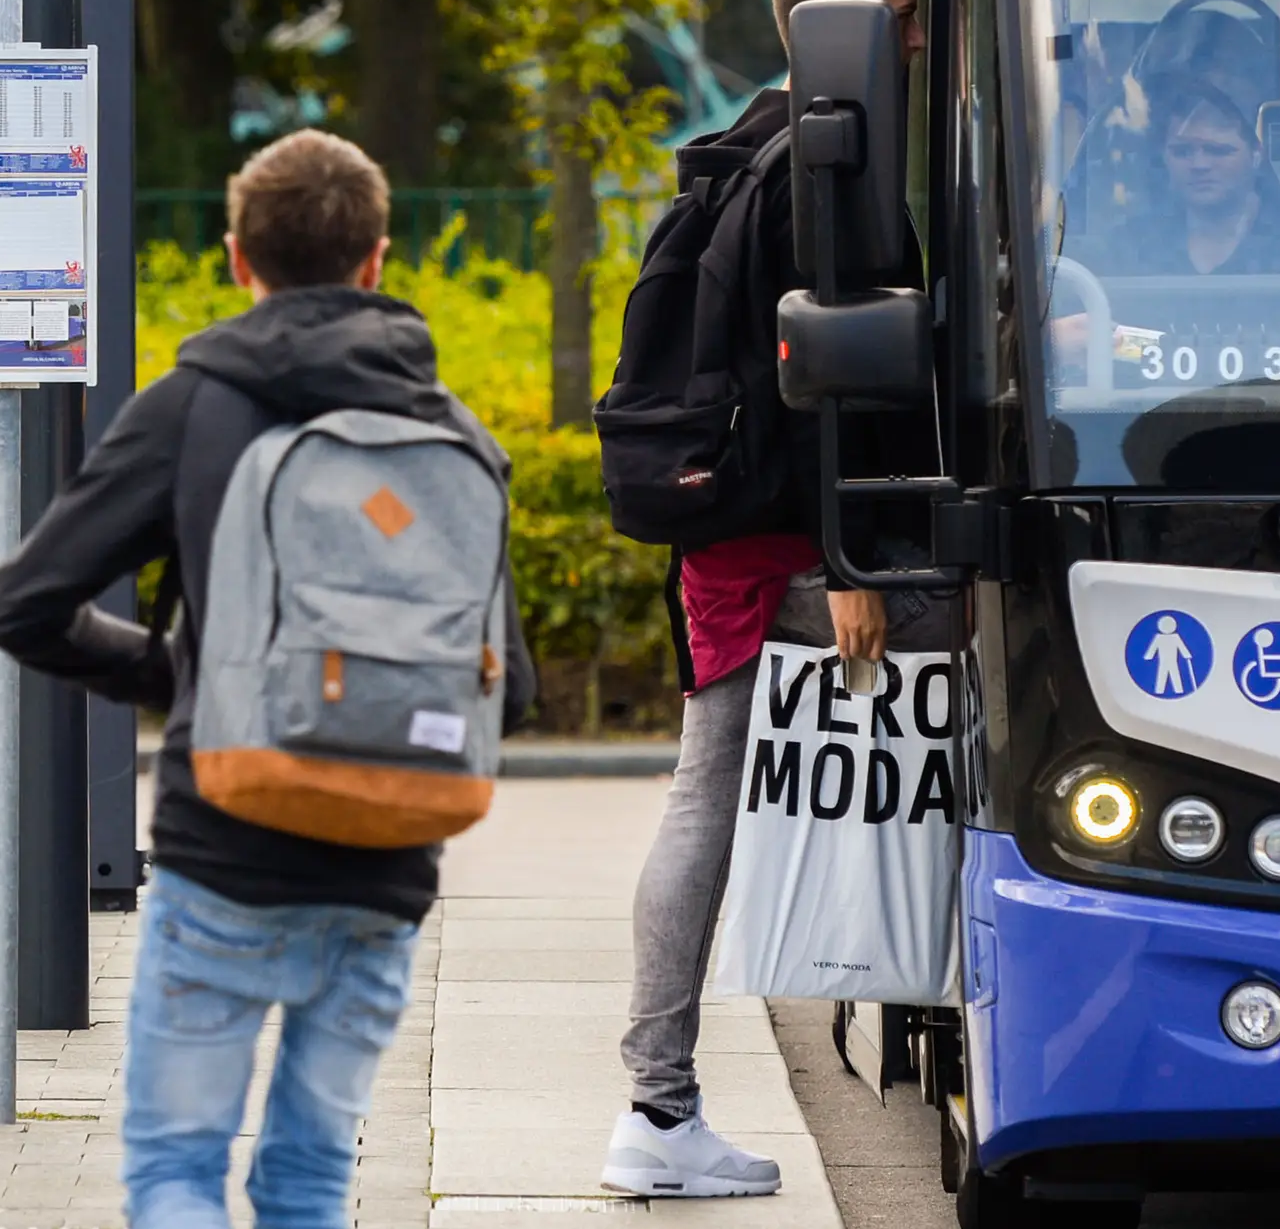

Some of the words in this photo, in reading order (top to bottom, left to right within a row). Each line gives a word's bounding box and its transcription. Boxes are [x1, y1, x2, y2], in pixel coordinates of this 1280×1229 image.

[768, 654, 955, 740] VERO
[745, 739, 956, 825] MODA
[812, 960, 839, 969] VERO
[841, 962, 871, 972] MODA
